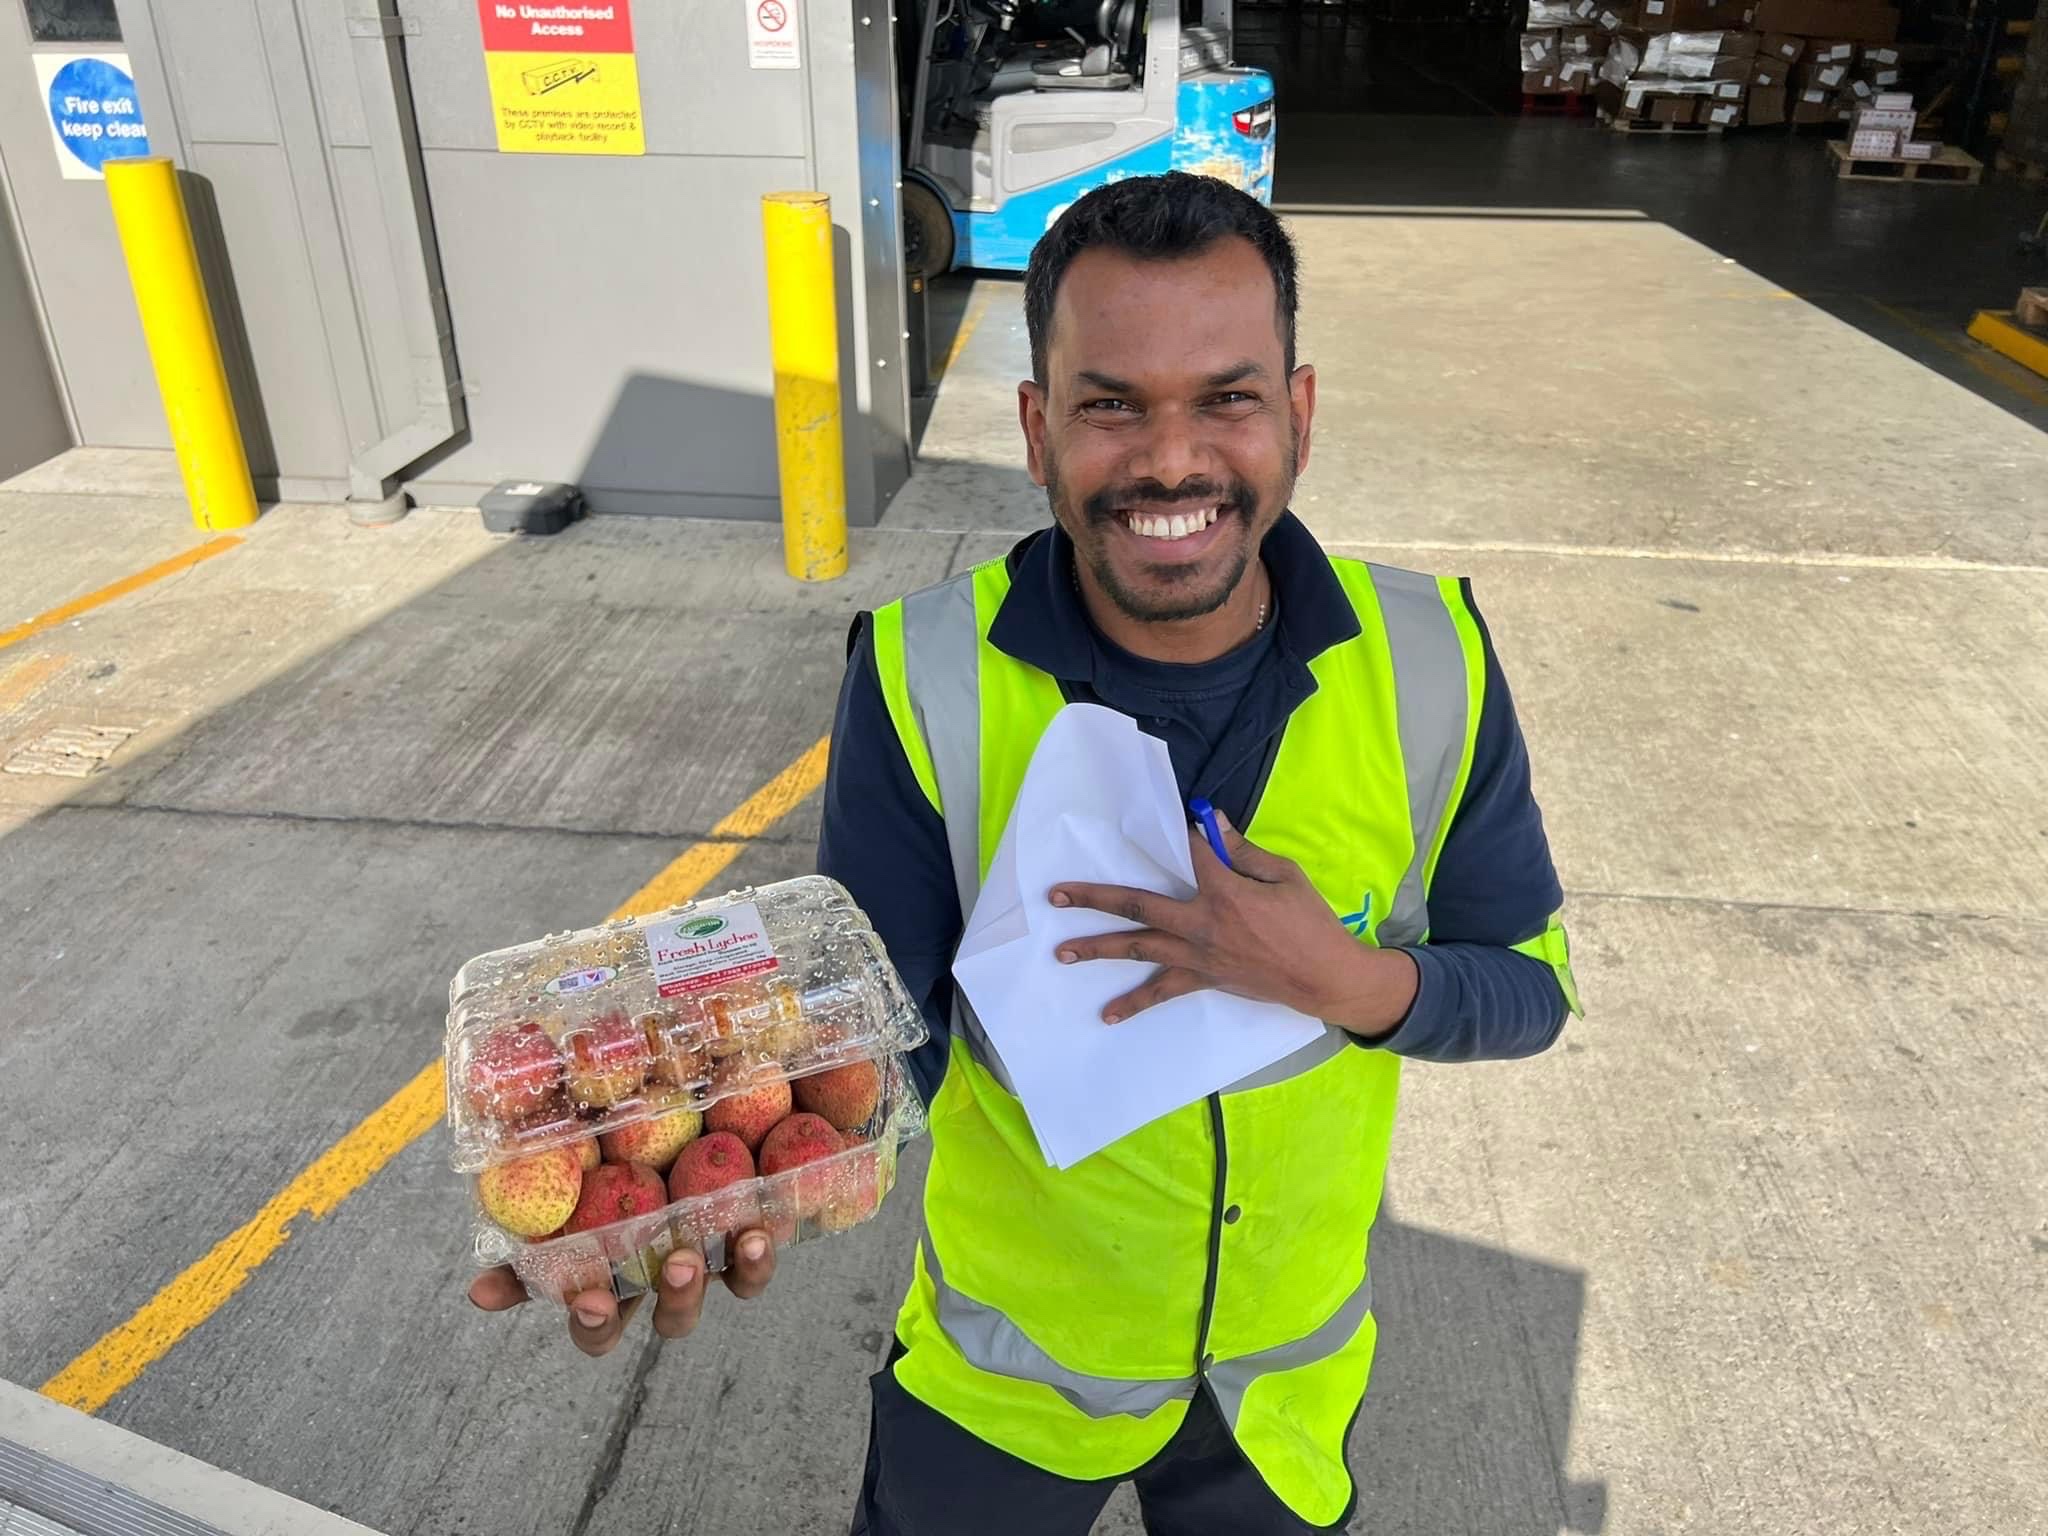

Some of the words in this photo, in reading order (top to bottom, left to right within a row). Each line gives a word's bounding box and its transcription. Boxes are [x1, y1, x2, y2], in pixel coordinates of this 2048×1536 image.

[495, 5, 516, 18] No
[519, 5, 614, 20] Unauthorised
[531, 22, 584, 36] Access
[64, 96, 100, 114] Fire
[102, 97, 134, 114] exit
[61, 119, 103, 141] keep
[518, 119, 544, 129] CCTV
[657, 943, 706, 961] Fresh
[708, 931, 759, 951] Lychee
